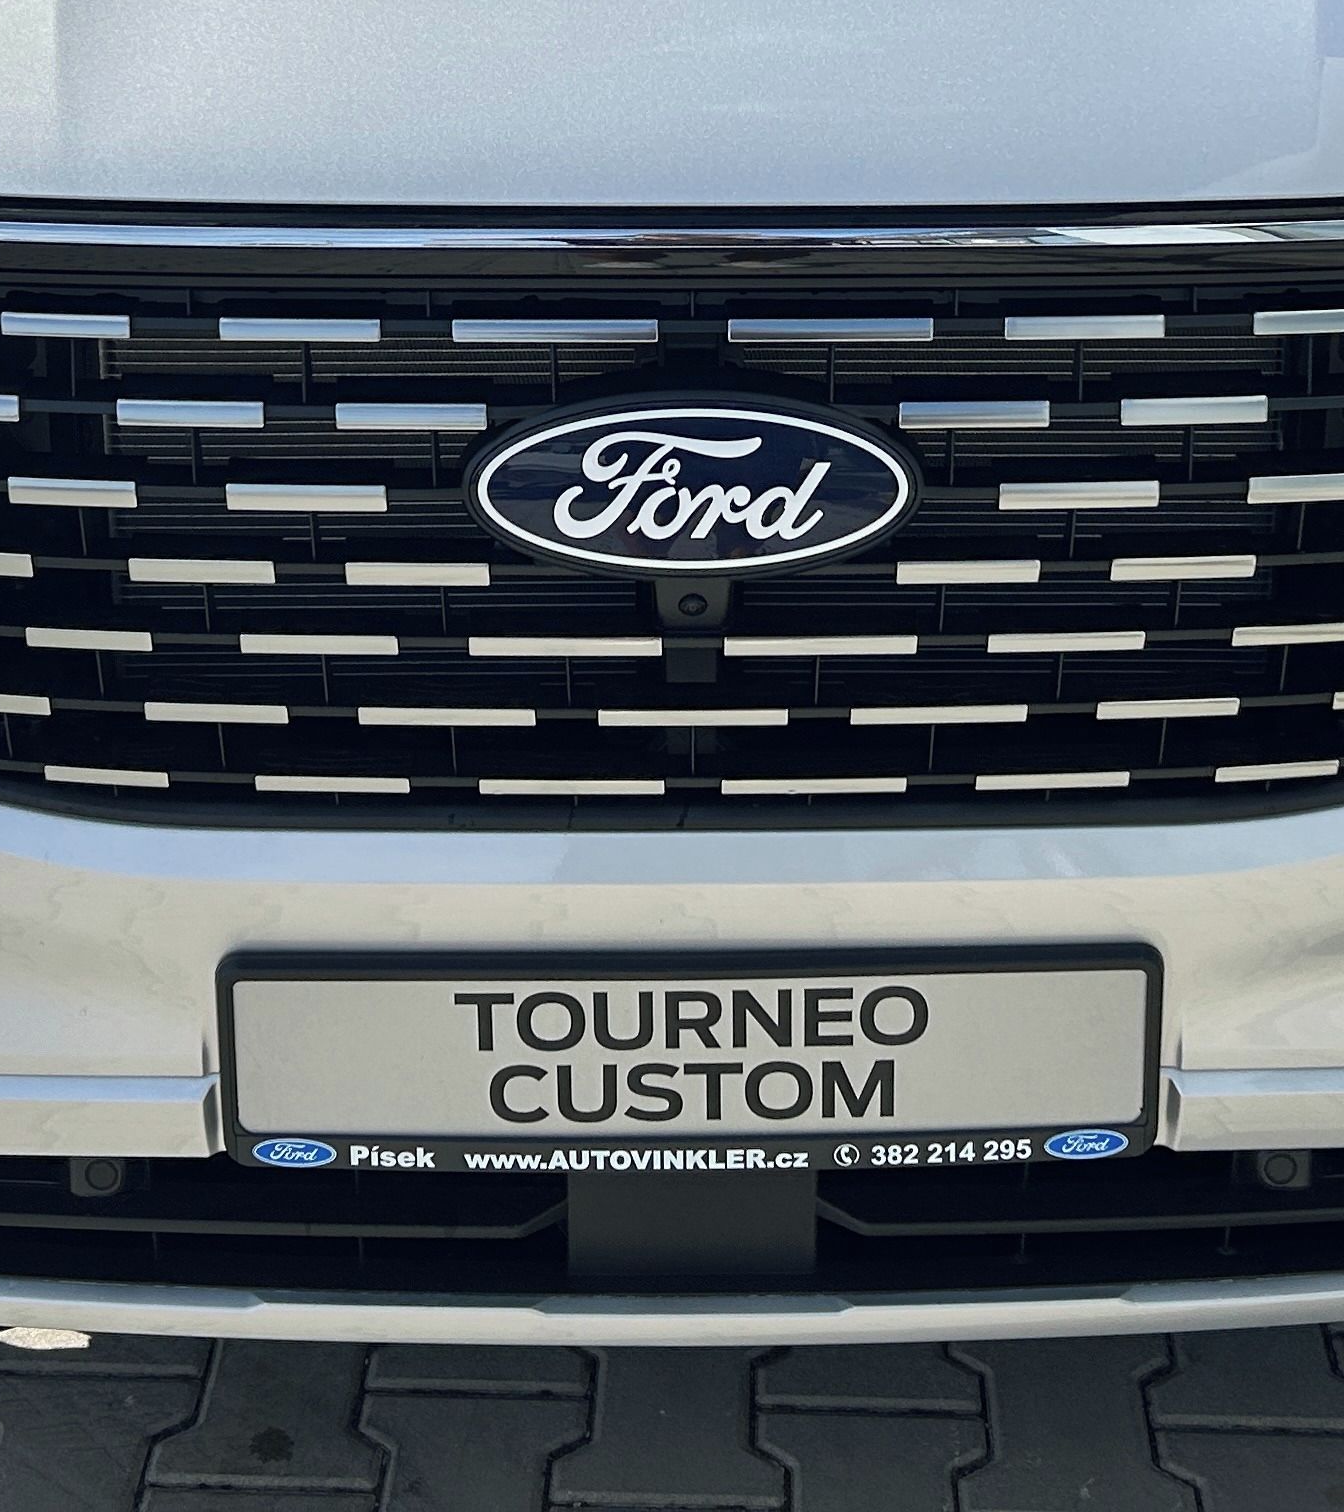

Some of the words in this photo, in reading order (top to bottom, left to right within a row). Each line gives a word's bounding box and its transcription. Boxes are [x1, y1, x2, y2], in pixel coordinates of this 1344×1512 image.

[552, 430, 832, 541] Ford
[453, 985, 929, 1052] TOURNEO
[489, 1059, 896, 1123] CUSTOM
[269, 1142, 319, 1161] Ford
[349, 1144, 436, 1169] Písek
[463, 1147, 809, 1171] www.AUTOVINKLER.cz
[870, 1143, 919, 1166] 382
[927, 1141, 976, 1164] 214
[983, 1138, 1032, 1161] 295
[1061, 1134, 1111, 1153] Ford
